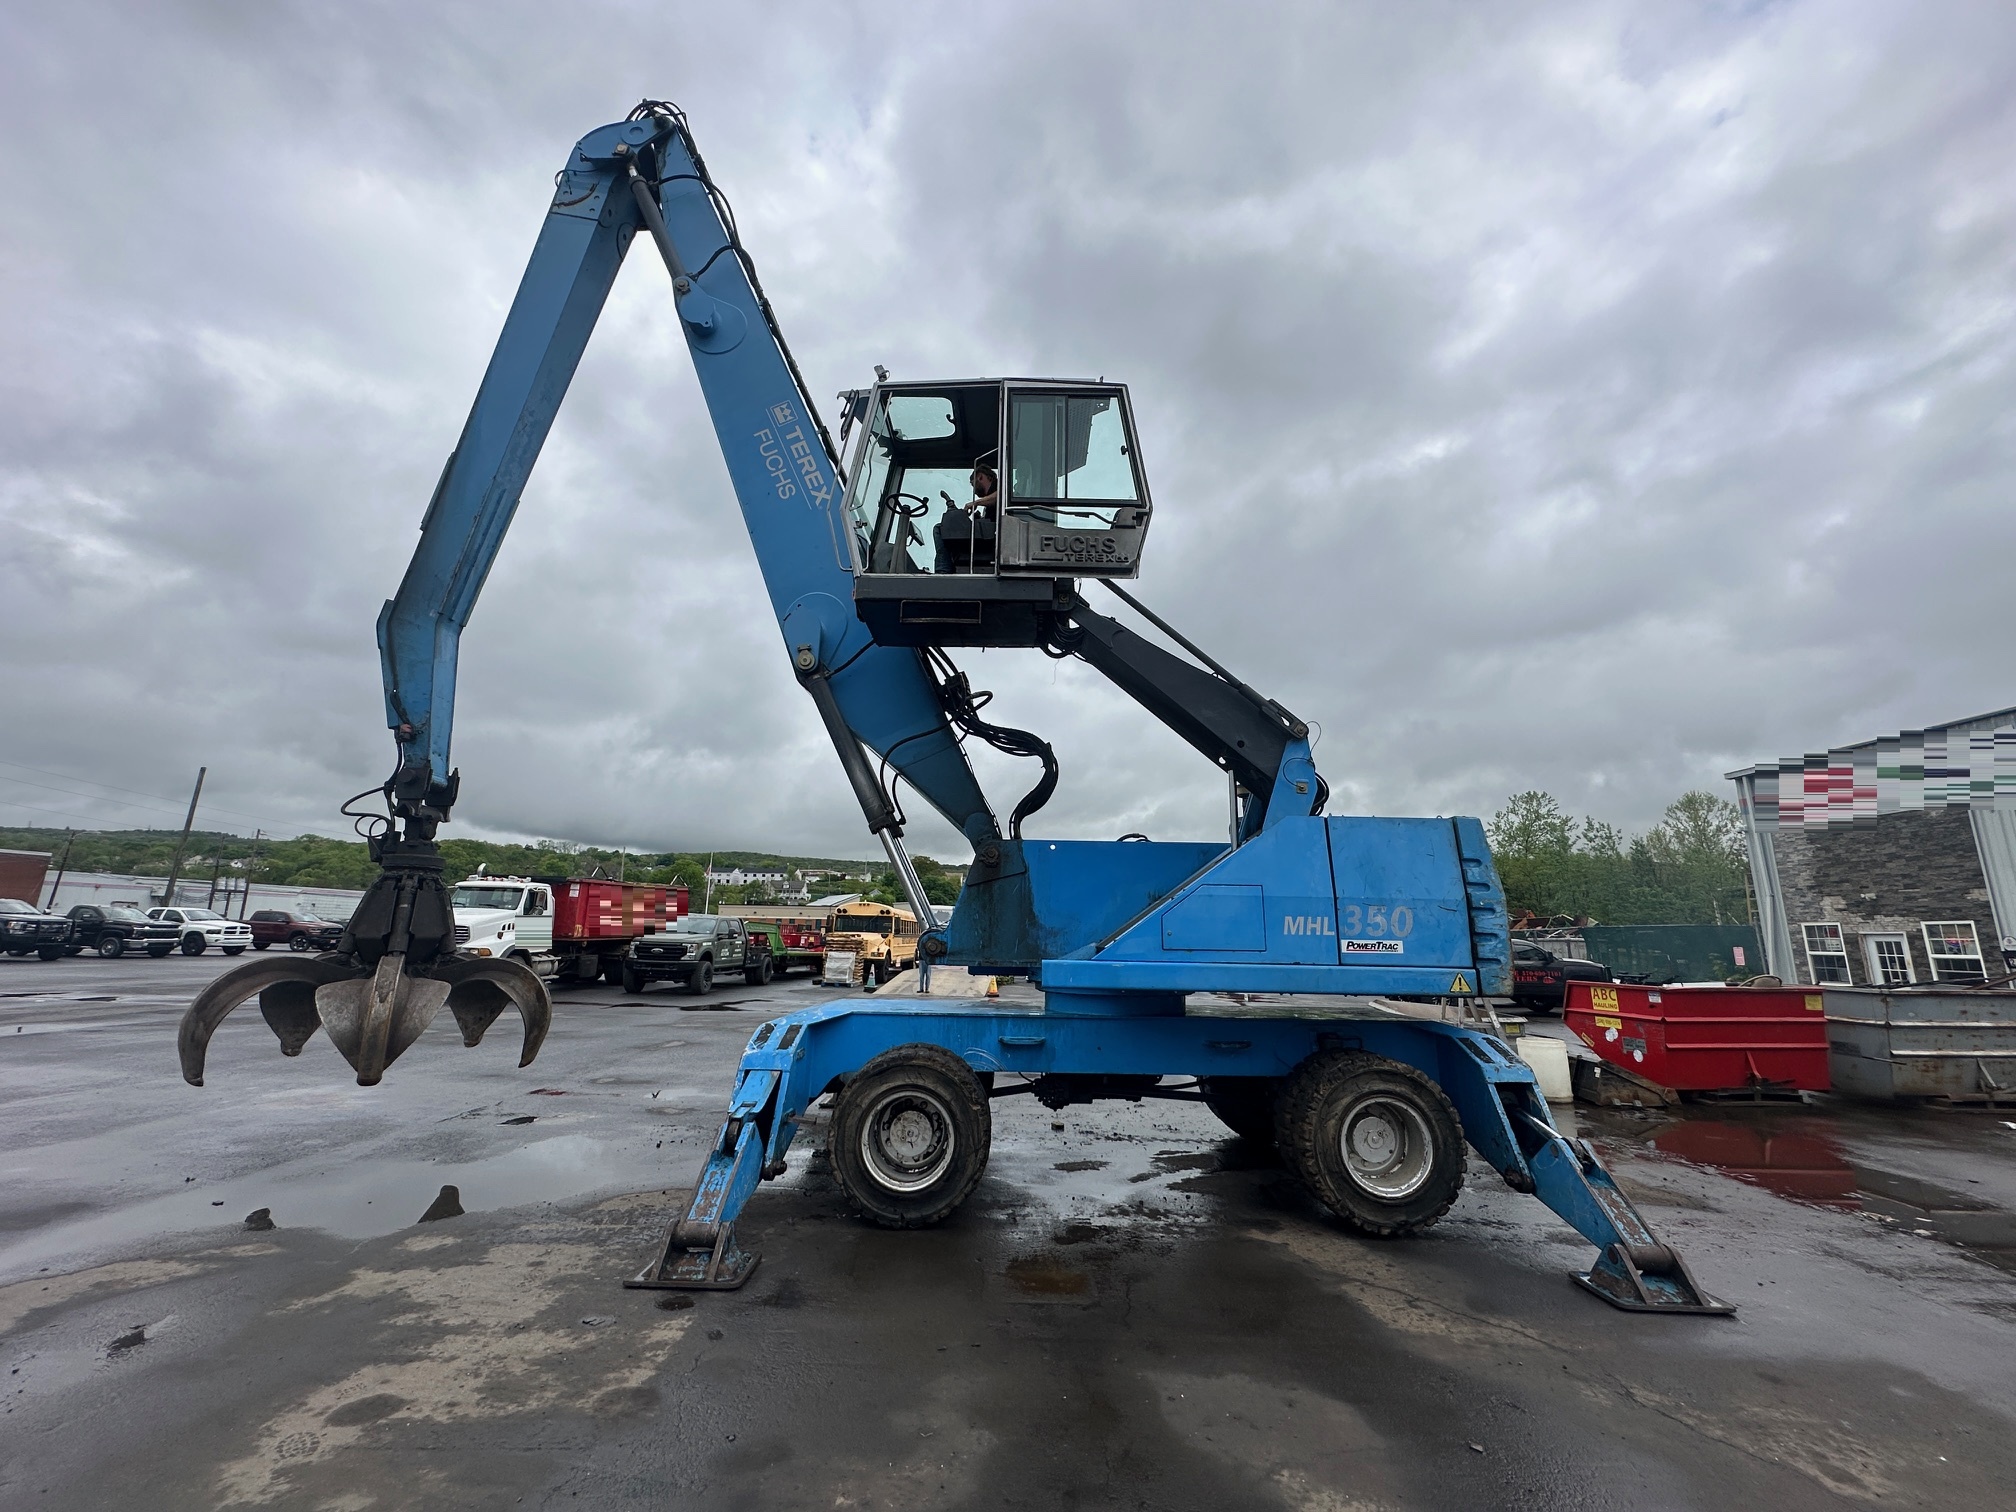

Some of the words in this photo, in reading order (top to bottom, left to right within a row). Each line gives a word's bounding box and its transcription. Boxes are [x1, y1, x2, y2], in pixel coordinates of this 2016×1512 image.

[753, 428, 796, 500] FUCHS
[785, 425, 831, 506] TEREX
[1040, 535, 1116, 554] FUCHS
[1064, 553, 1115, 563] TEREX
[1283, 916, 1335, 936] MHL
[1344, 905, 1413, 938] 350
[1593, 988, 1617, 1002] ABC
